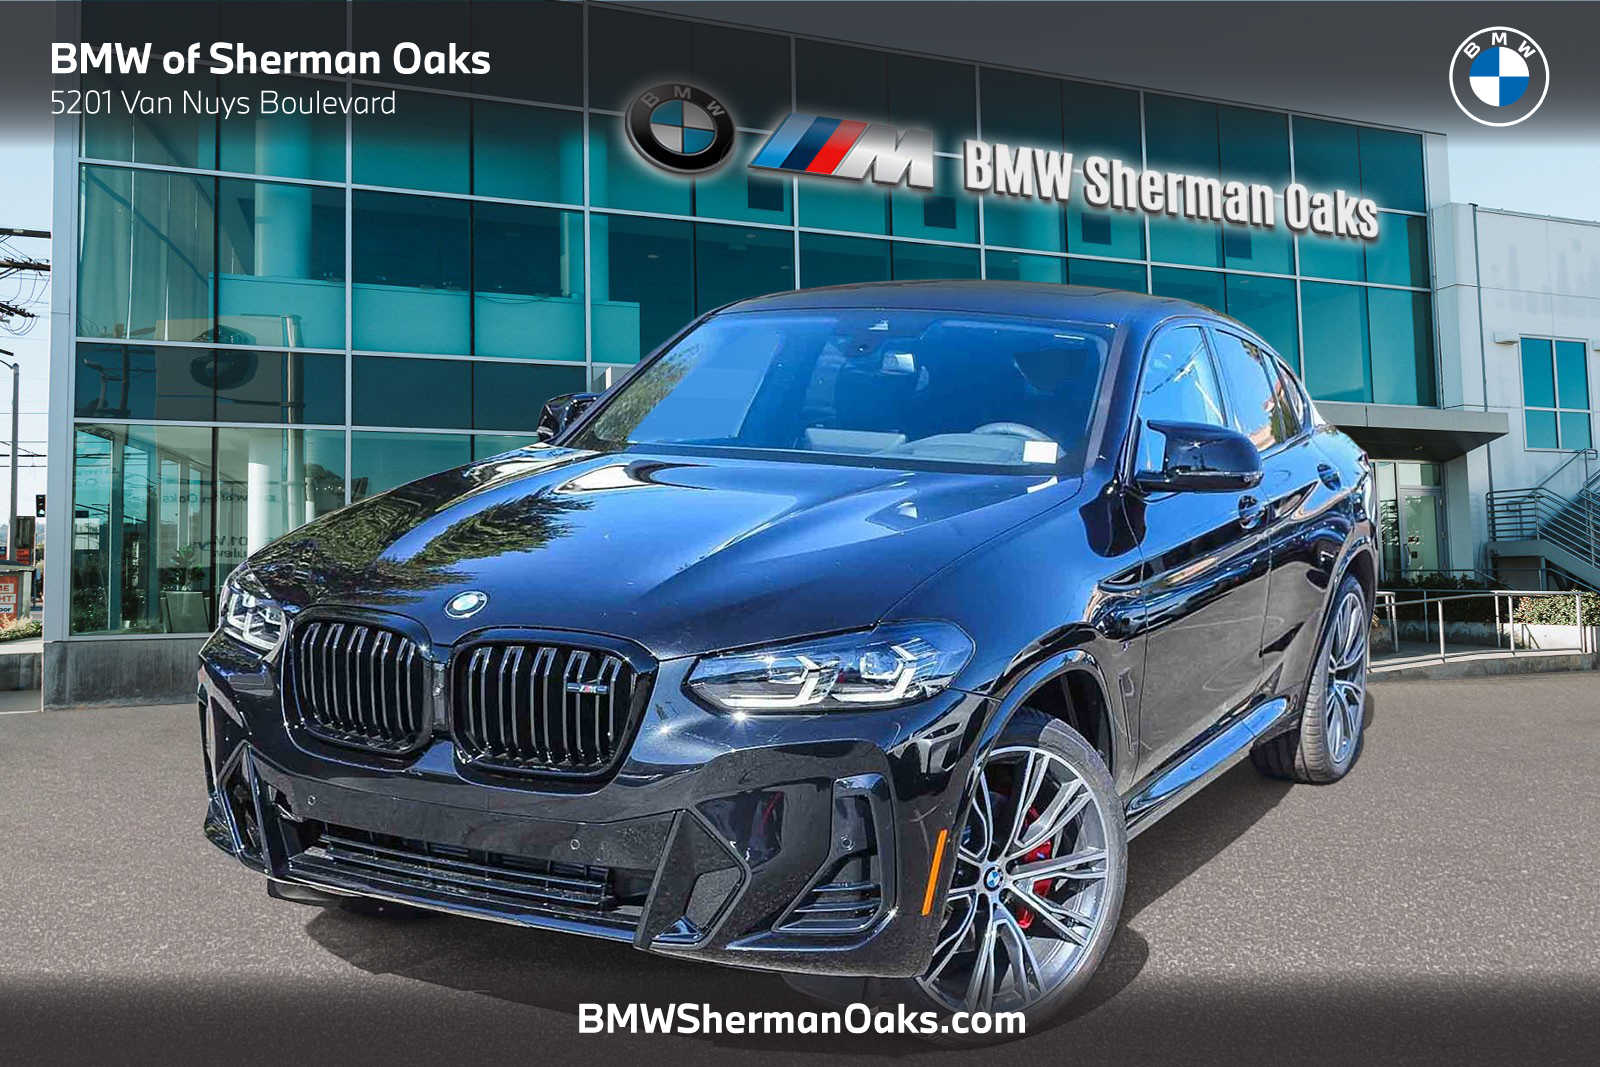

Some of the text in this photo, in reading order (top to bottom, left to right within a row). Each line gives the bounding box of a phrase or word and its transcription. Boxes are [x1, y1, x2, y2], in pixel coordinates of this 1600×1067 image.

[640, 85, 726, 118] BMW
[964, 139, 1379, 240] BMW Sherman Oaks
